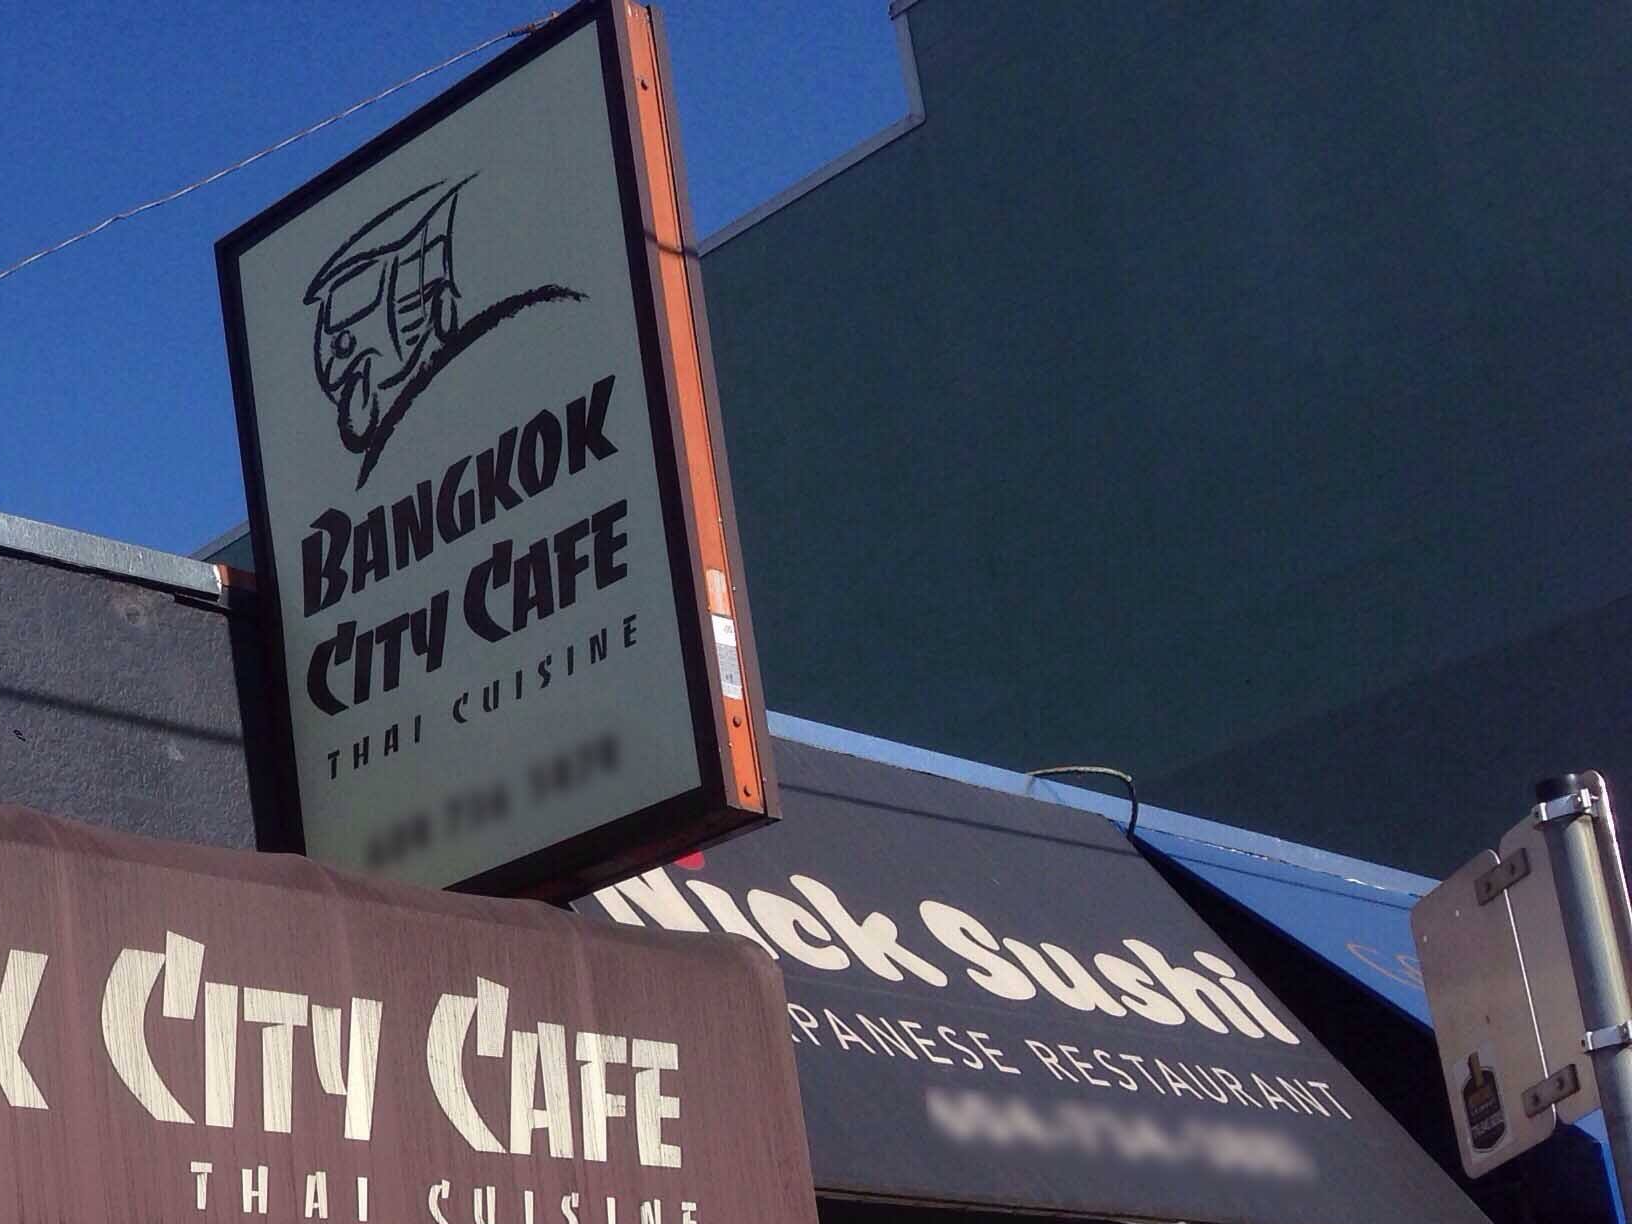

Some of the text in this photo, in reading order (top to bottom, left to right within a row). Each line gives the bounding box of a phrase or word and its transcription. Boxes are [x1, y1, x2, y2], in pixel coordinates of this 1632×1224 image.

[301, 375, 617, 618] BANGKOK
[306, 499, 630, 718] CITY CAFE
[327, 715, 422, 781] THAI
[452, 614, 640, 725] CUISINE
[593, 851, 1300, 1046] Nick Sushi
[101, 930, 383, 1141] CITY
[427, 976, 682, 1169] CAFE
[786, 1002, 1353, 1121] PANESE RESTAURANT
[190, 1161, 368, 1222] THAI
